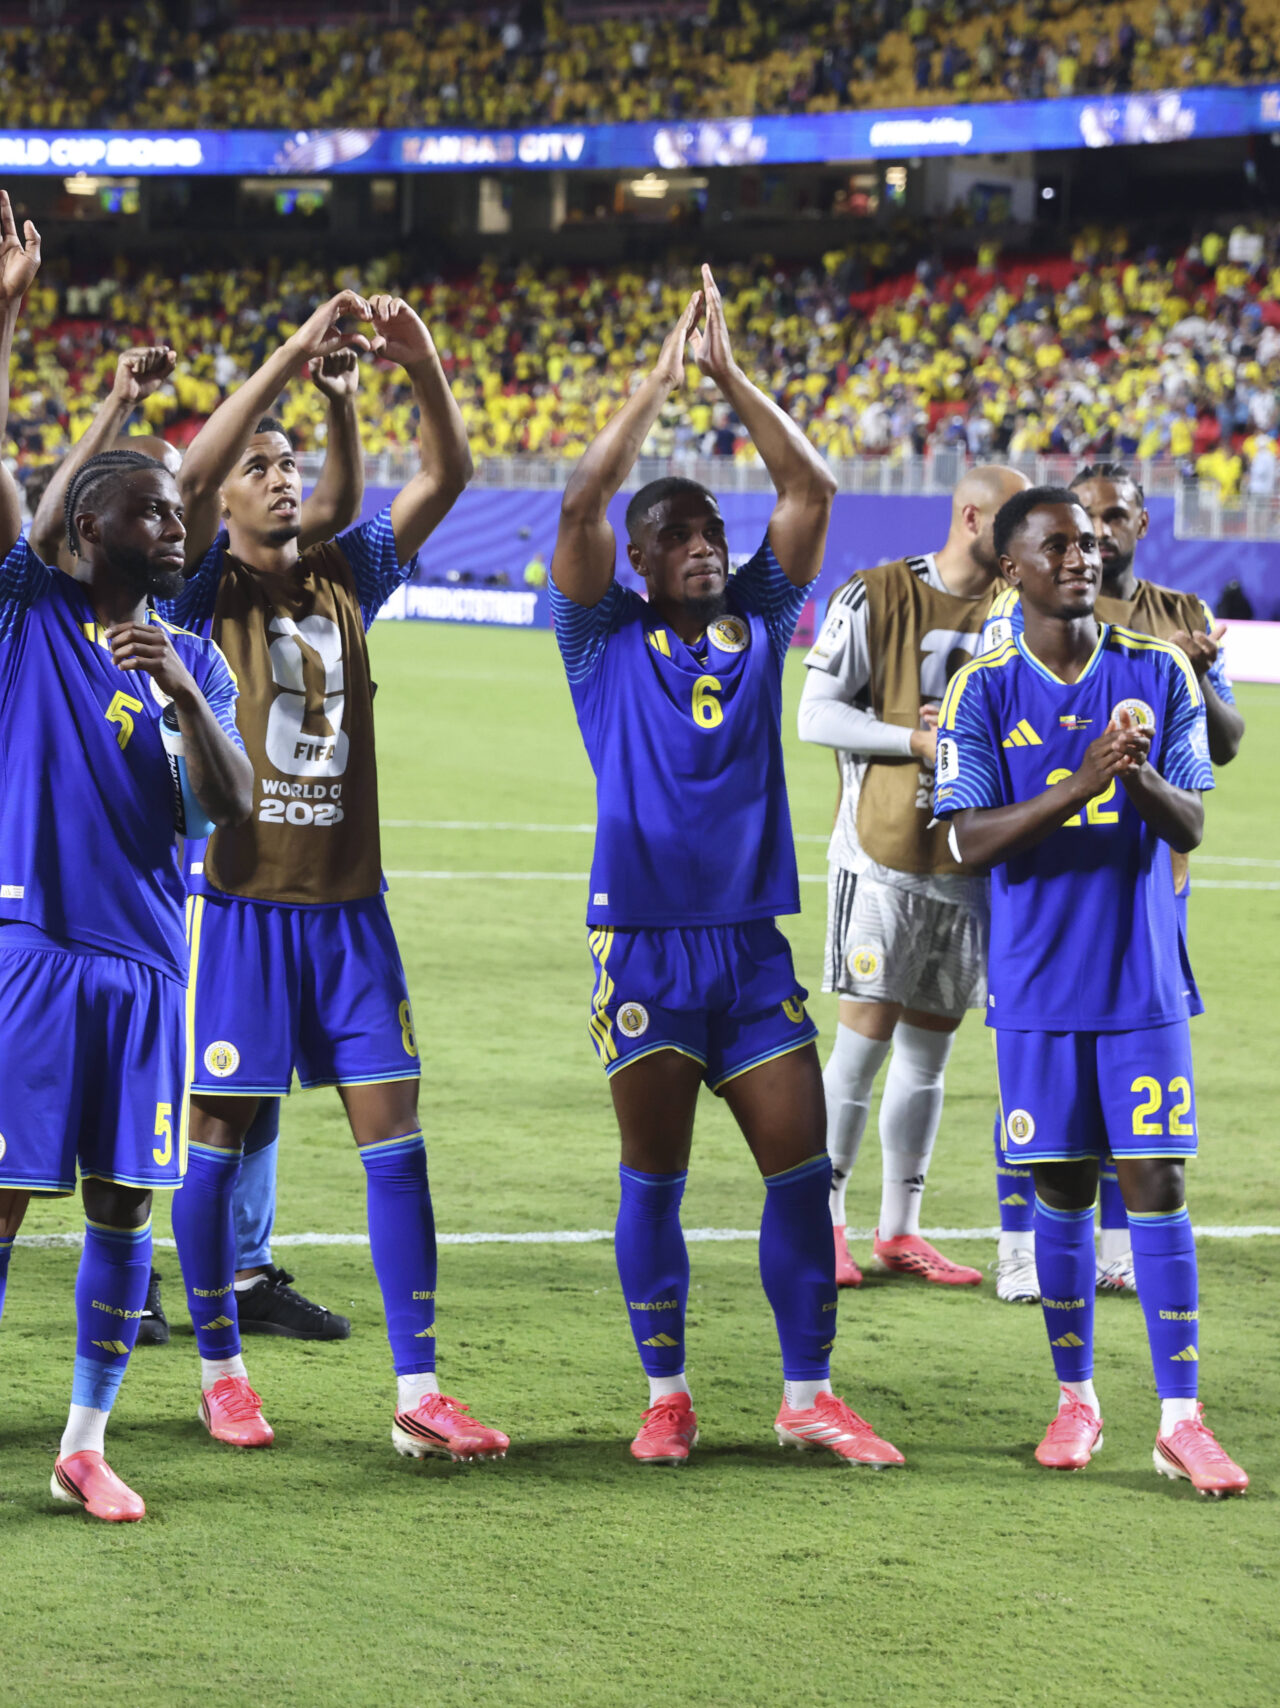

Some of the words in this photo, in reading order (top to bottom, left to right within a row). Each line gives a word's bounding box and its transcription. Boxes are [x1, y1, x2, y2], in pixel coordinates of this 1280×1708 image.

[50, 138, 106, 166] CUP
[519, 133, 585, 163] CITY
[104, 690, 144, 750] 5
[692, 675, 724, 729] 6
[294, 741, 334, 762] FIFA
[262, 778, 326, 800] WORLD
[398, 1000, 417, 1057] 8
[1130, 1076, 1194, 1135] 22
[153, 1102, 172, 1166] 5
[630, 1300, 677, 1312] CURAÇAO
